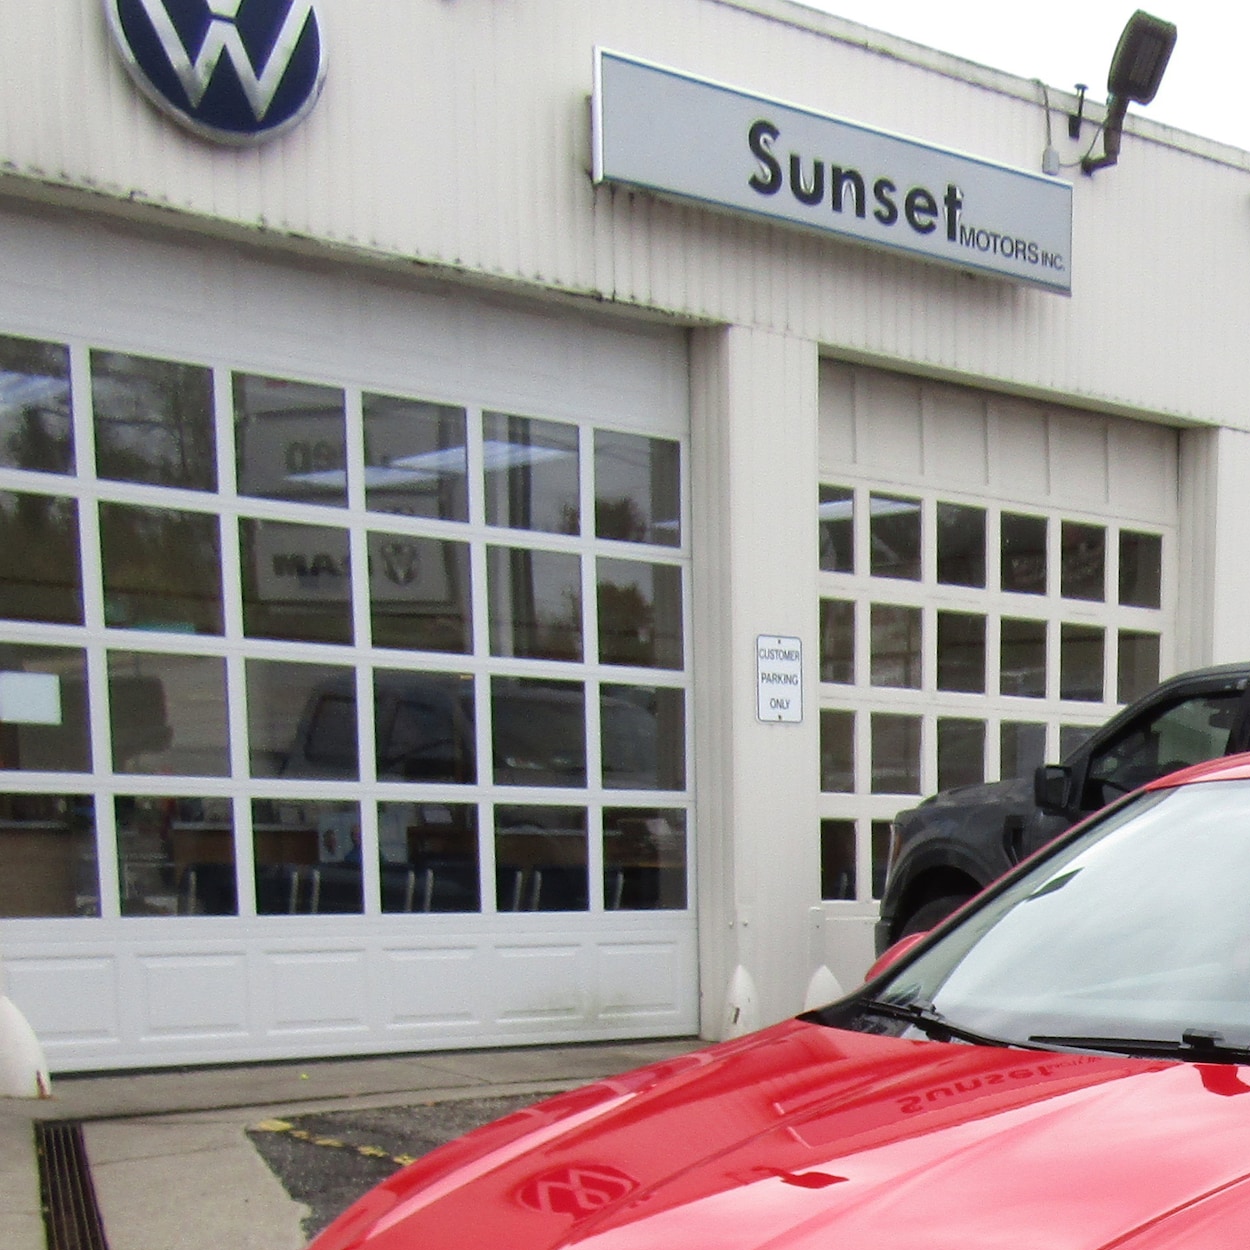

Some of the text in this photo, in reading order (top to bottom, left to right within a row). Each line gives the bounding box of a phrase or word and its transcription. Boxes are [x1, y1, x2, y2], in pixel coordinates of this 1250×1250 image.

[748, 119, 963, 243] Sunset
[960, 223, 1066, 272] MOTORS INC.
[759, 648, 800, 662] CUSTOMER
[760, 671, 799, 686] PARKING
[769, 697, 791, 710] ONLY
